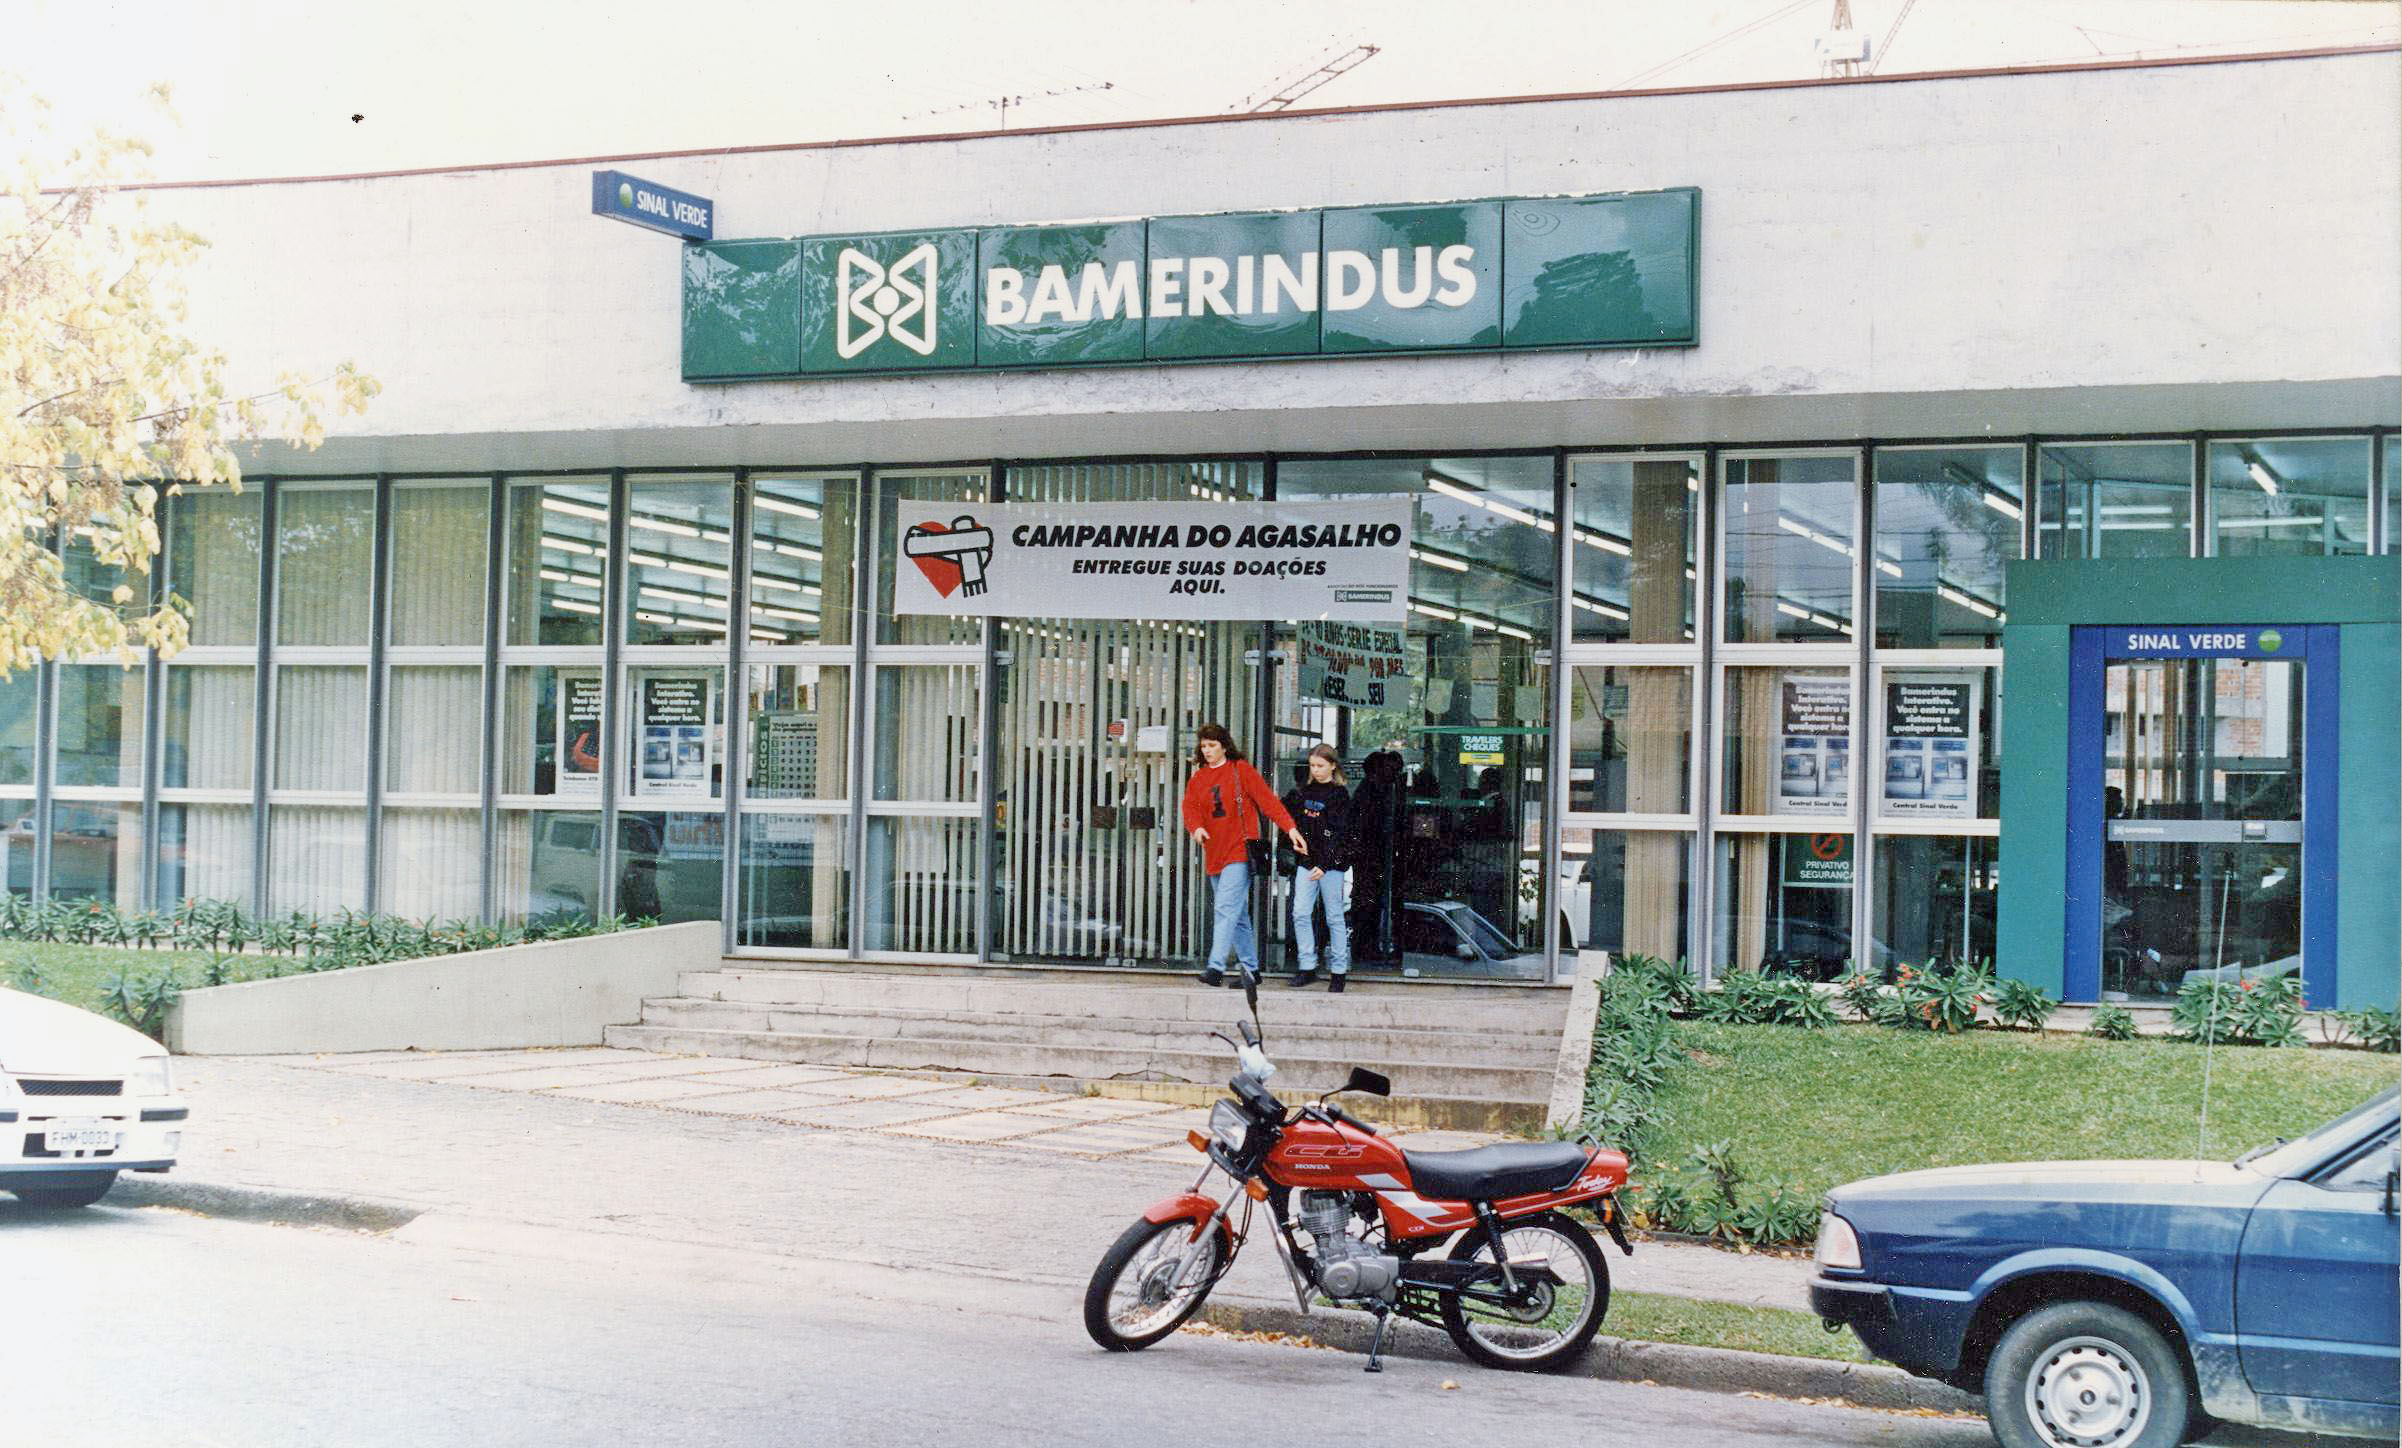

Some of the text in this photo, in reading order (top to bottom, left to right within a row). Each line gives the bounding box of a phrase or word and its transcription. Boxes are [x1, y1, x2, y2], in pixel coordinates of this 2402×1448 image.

[637, 190, 708, 228] SINAL VERDE
[985, 243, 1477, 327] BAMERINDUS
[1012, 523, 1401, 548] CAMPANHA DO AGASALHO
[1072, 557, 1327, 580] ENTREGUE SUAS DOAÇÕES
[1169, 578, 1225, 595] AQUI.
[2128, 634, 2246, 650] SINAL VERDE
[1901, 687, 1958, 696] Bamerindus
[1904, 696, 1953, 705] Interativo.
[1791, 705, 1812, 713] Você
[1896, 705, 1918, 714] Você
[1920, 706, 1946, 714] entra
[1905, 714, 1941, 723] sistema
[1788, 722, 1850, 733] qualquer hor
[1893, 724, 1963, 734] qualquer hora.
[1461, 736, 1503, 744] TRAVELERS
[1464, 743, 1501, 752] CHEQUES
[1892, 802, 1917, 810] Central
[1806, 861, 1849, 870] PRIVATIVO
[1284, 1143, 1367, 1159] CG
[1295, 1163, 1331, 1171] HONDA
